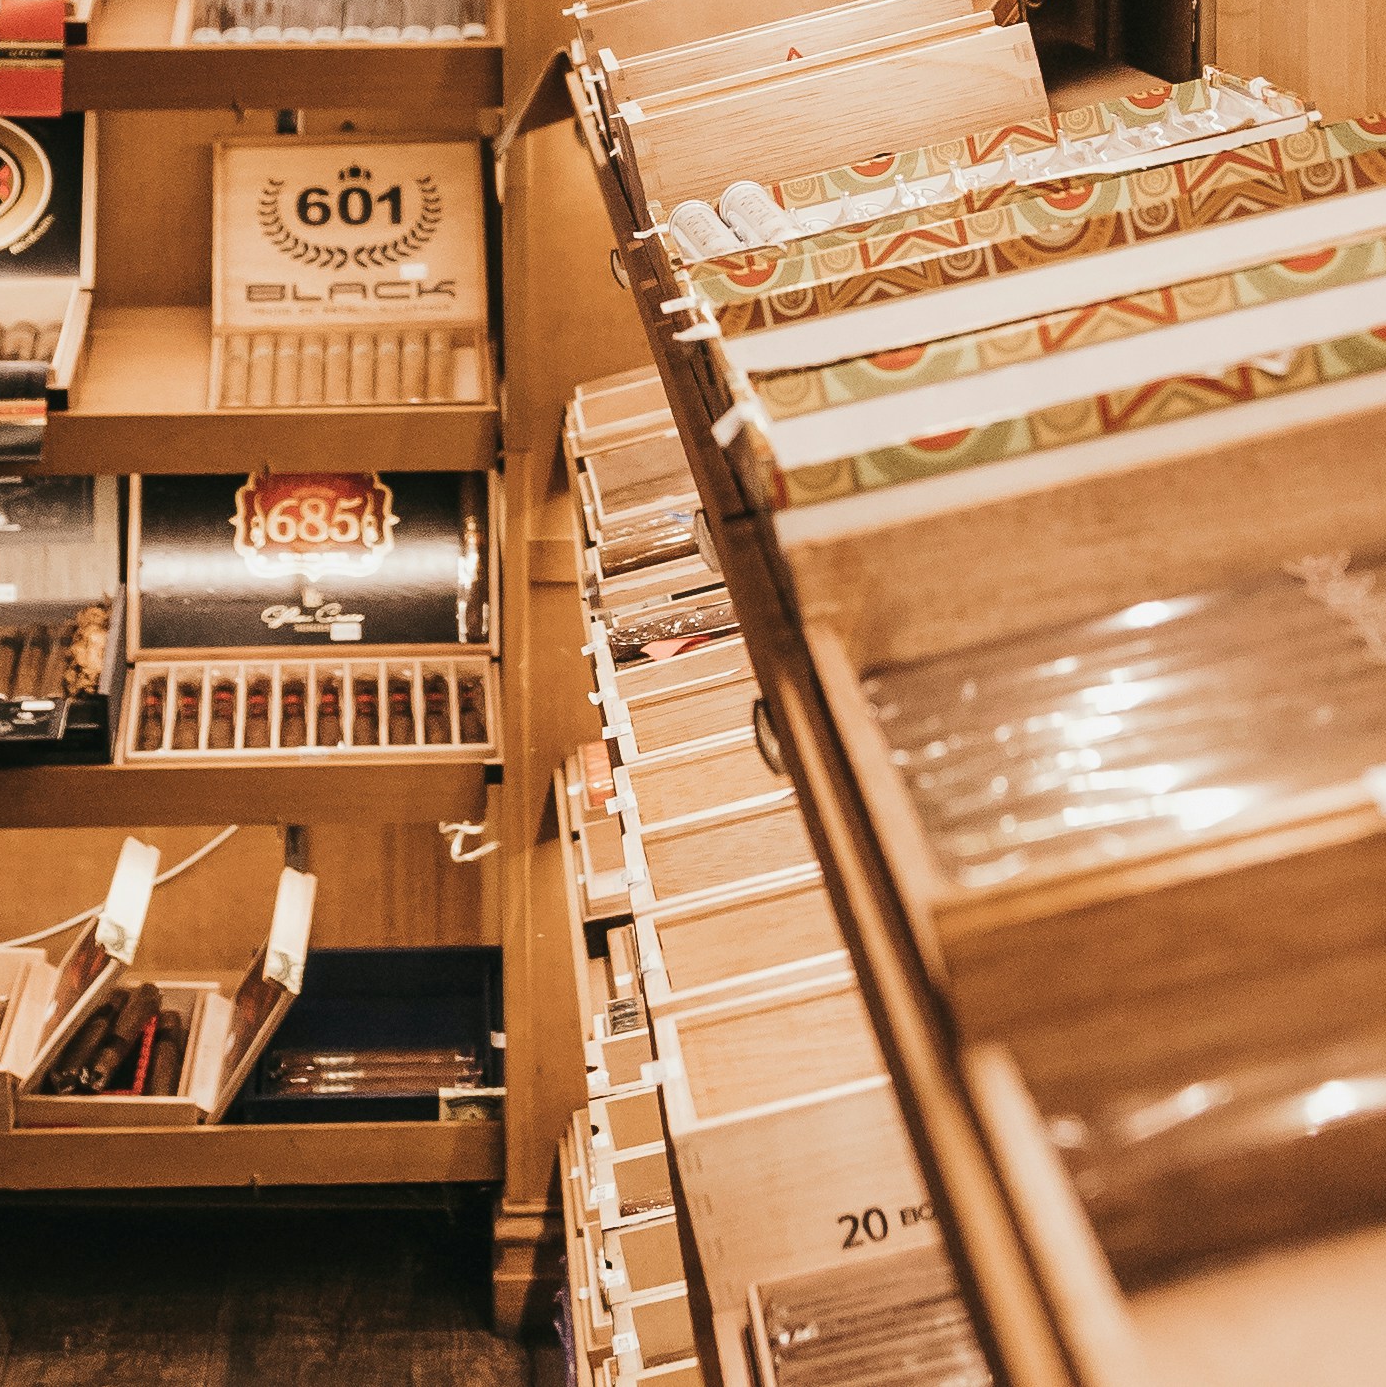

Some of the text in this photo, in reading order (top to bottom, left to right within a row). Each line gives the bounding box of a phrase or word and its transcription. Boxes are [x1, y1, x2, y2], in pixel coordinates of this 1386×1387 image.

[297, 185, 403, 227] 601
[246, 278, 457, 303] BLACK
[266, 497, 363, 544] 685
[836, 1206, 889, 1251] 20
